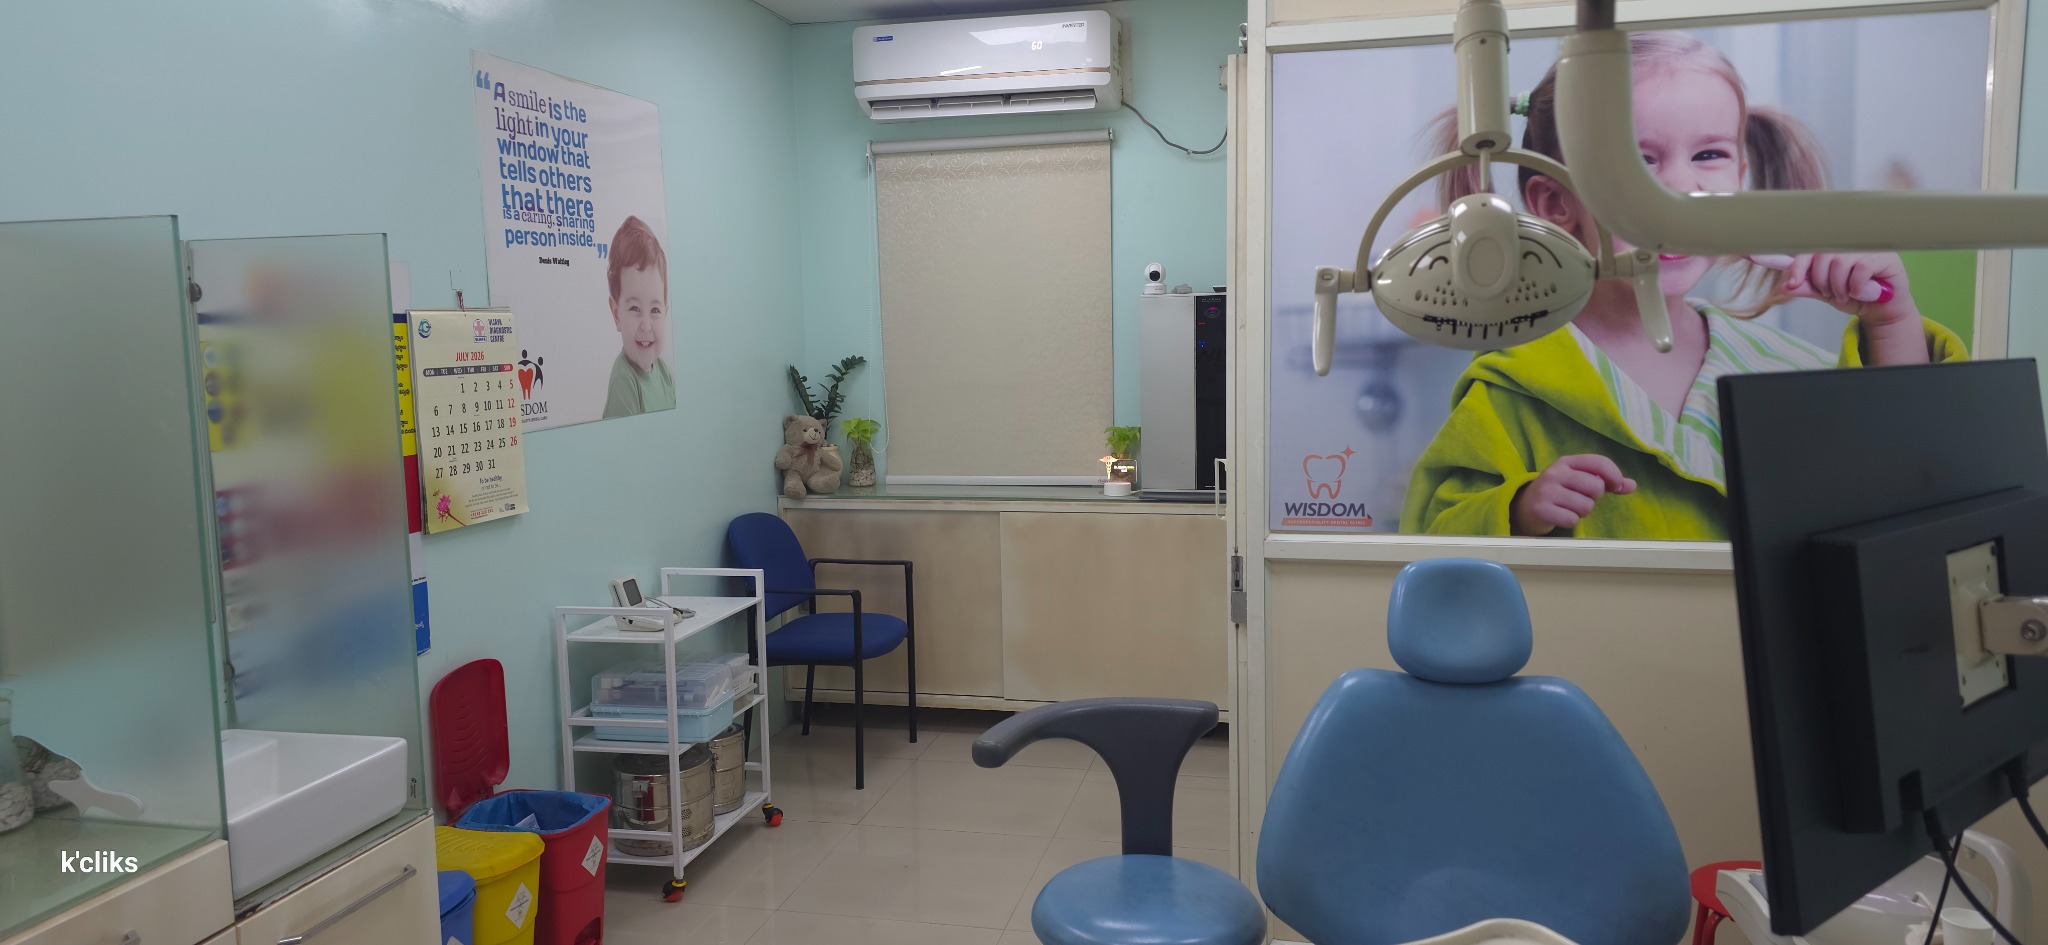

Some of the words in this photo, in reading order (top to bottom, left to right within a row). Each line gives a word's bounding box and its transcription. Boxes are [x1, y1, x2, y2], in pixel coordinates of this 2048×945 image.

[1031, 40, 1042, 50] 60
[508, 89, 546, 114] smile
[549, 97, 562, 121] is
[564, 100, 586, 123] the
[495, 107, 534, 140] light
[535, 116, 549, 139] in
[551, 125, 588, 149] your
[497, 138, 559, 164] window
[561, 146, 590, 169] that
[499, 156, 537, 184] tells
[539, 166, 592, 193] others
[501, 183, 544, 213] that
[546, 189, 594, 218] there
[503, 208, 512, 220] is
[514, 210, 521, 221] a
[556, 214, 595, 233] sharing
[505, 228, 557, 248] person
[558, 229, 596, 247] inside.
[456, 352, 469, 362] JULY
[471, 351, 485, 361] 2026
[461, 382, 464, 394] 1
[474, 382, 478, 392] 2
[486, 381, 490, 391] 3
[498, 380, 502, 390] 4
[510, 379, 514, 389] 5
[434, 406, 439, 416] 6
[449, 404, 453, 415] 7
[462, 403, 466, 413] 8
[475, 401, 479, 412] 9
[484, 400, 492, 411] 10
[496, 400, 503, 410] 11
[508, 398, 515, 408] 12
[521, 401, 548, 416] SDOM
[432, 427, 440, 438] 13
[446, 425, 455, 436] 14
[460, 423, 468, 434] 15
[473, 422, 480, 432] 16
[485, 420, 493, 430] 17
[497, 419, 504, 429] 18
[509, 417, 516, 428] 19
[434, 447, 442, 458] 20
[448, 445, 456, 456] 21
[461, 443, 469, 454] 22
[474, 441, 482, 452] 23
[487, 440, 494, 450] 24
[498, 438, 506, 448] 25
[510, 436, 517, 446] 26
[436, 468, 443, 479] 27
[449, 466, 458, 477] 28
[462, 463, 470, 474] 29
[476, 461, 483, 472] 30
[488, 459, 495, 470] 31
[1285, 502, 1365, 517] WISDOM
